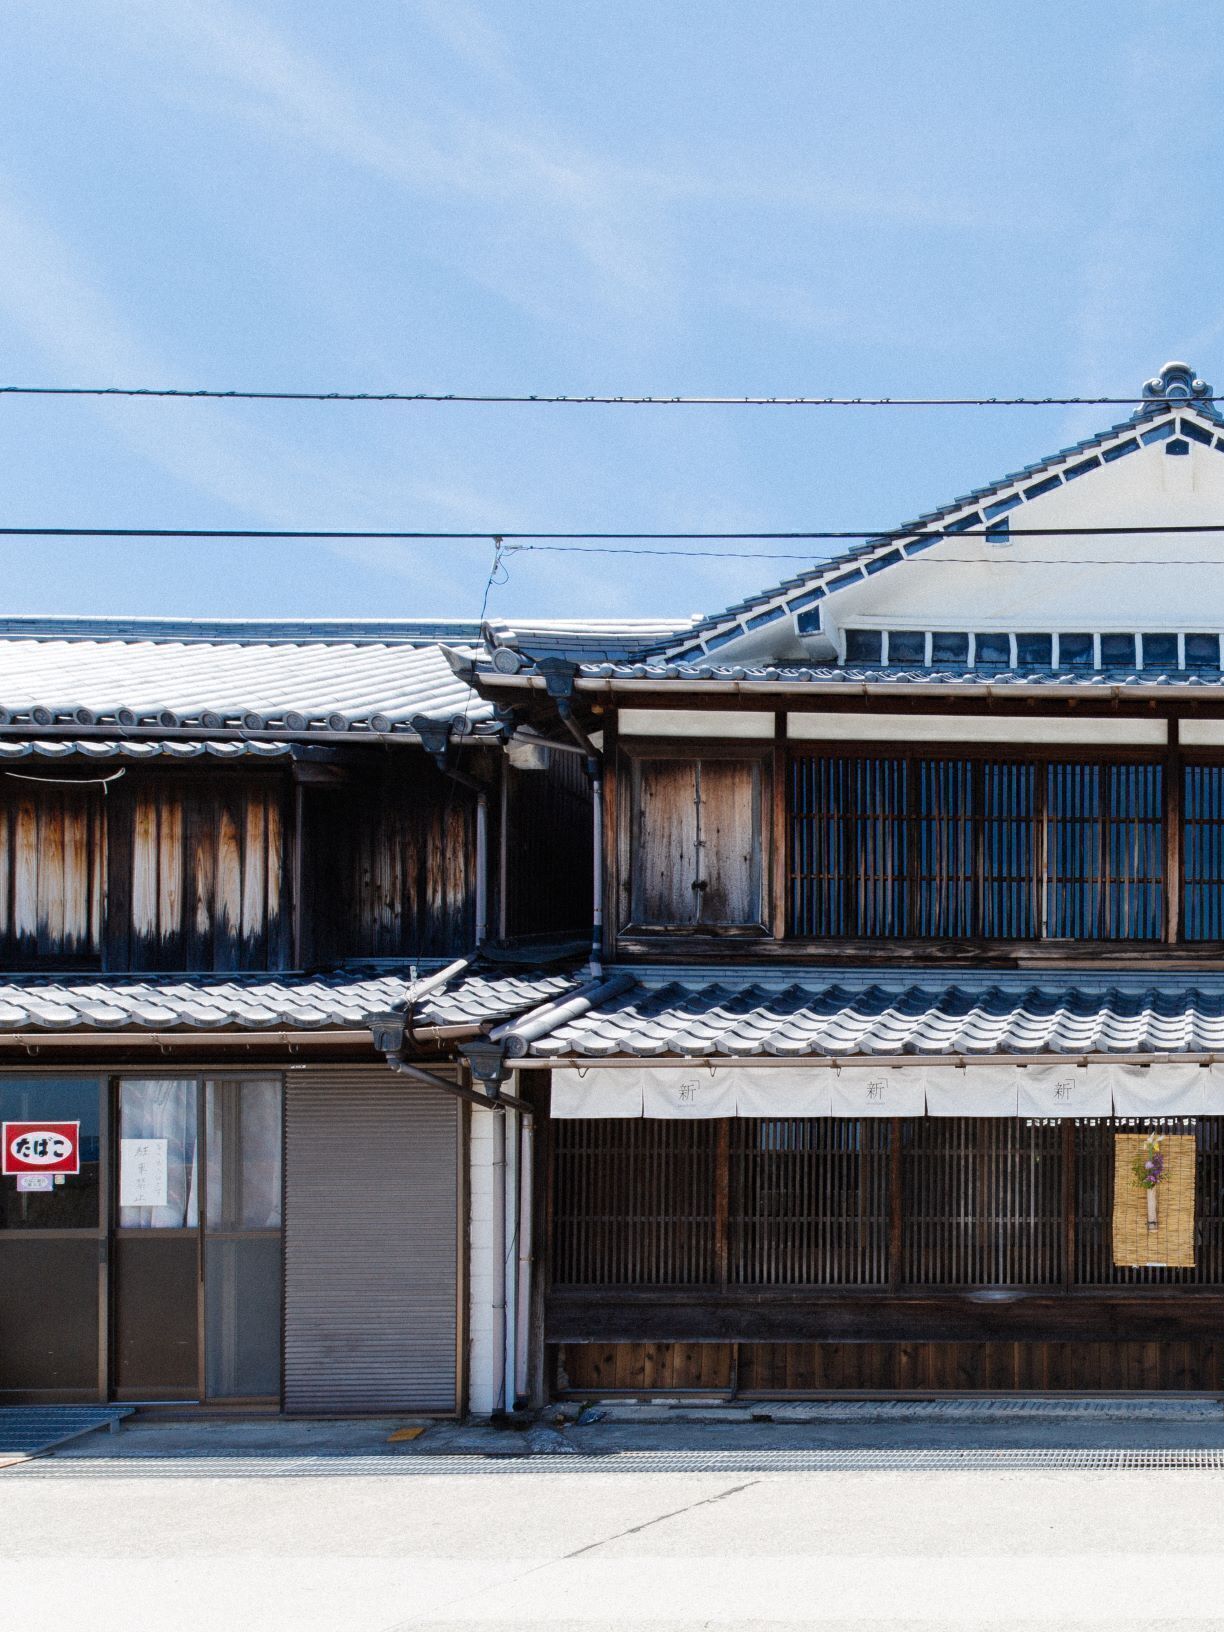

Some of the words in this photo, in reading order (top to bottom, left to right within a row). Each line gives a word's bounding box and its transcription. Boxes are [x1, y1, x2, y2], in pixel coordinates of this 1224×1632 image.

[678, 1083, 697, 1102] 新
[866, 1081, 885, 1100] 新
[1053, 1082, 1072, 1101] 新
[16, 1137, 65, 1158] たばこ
